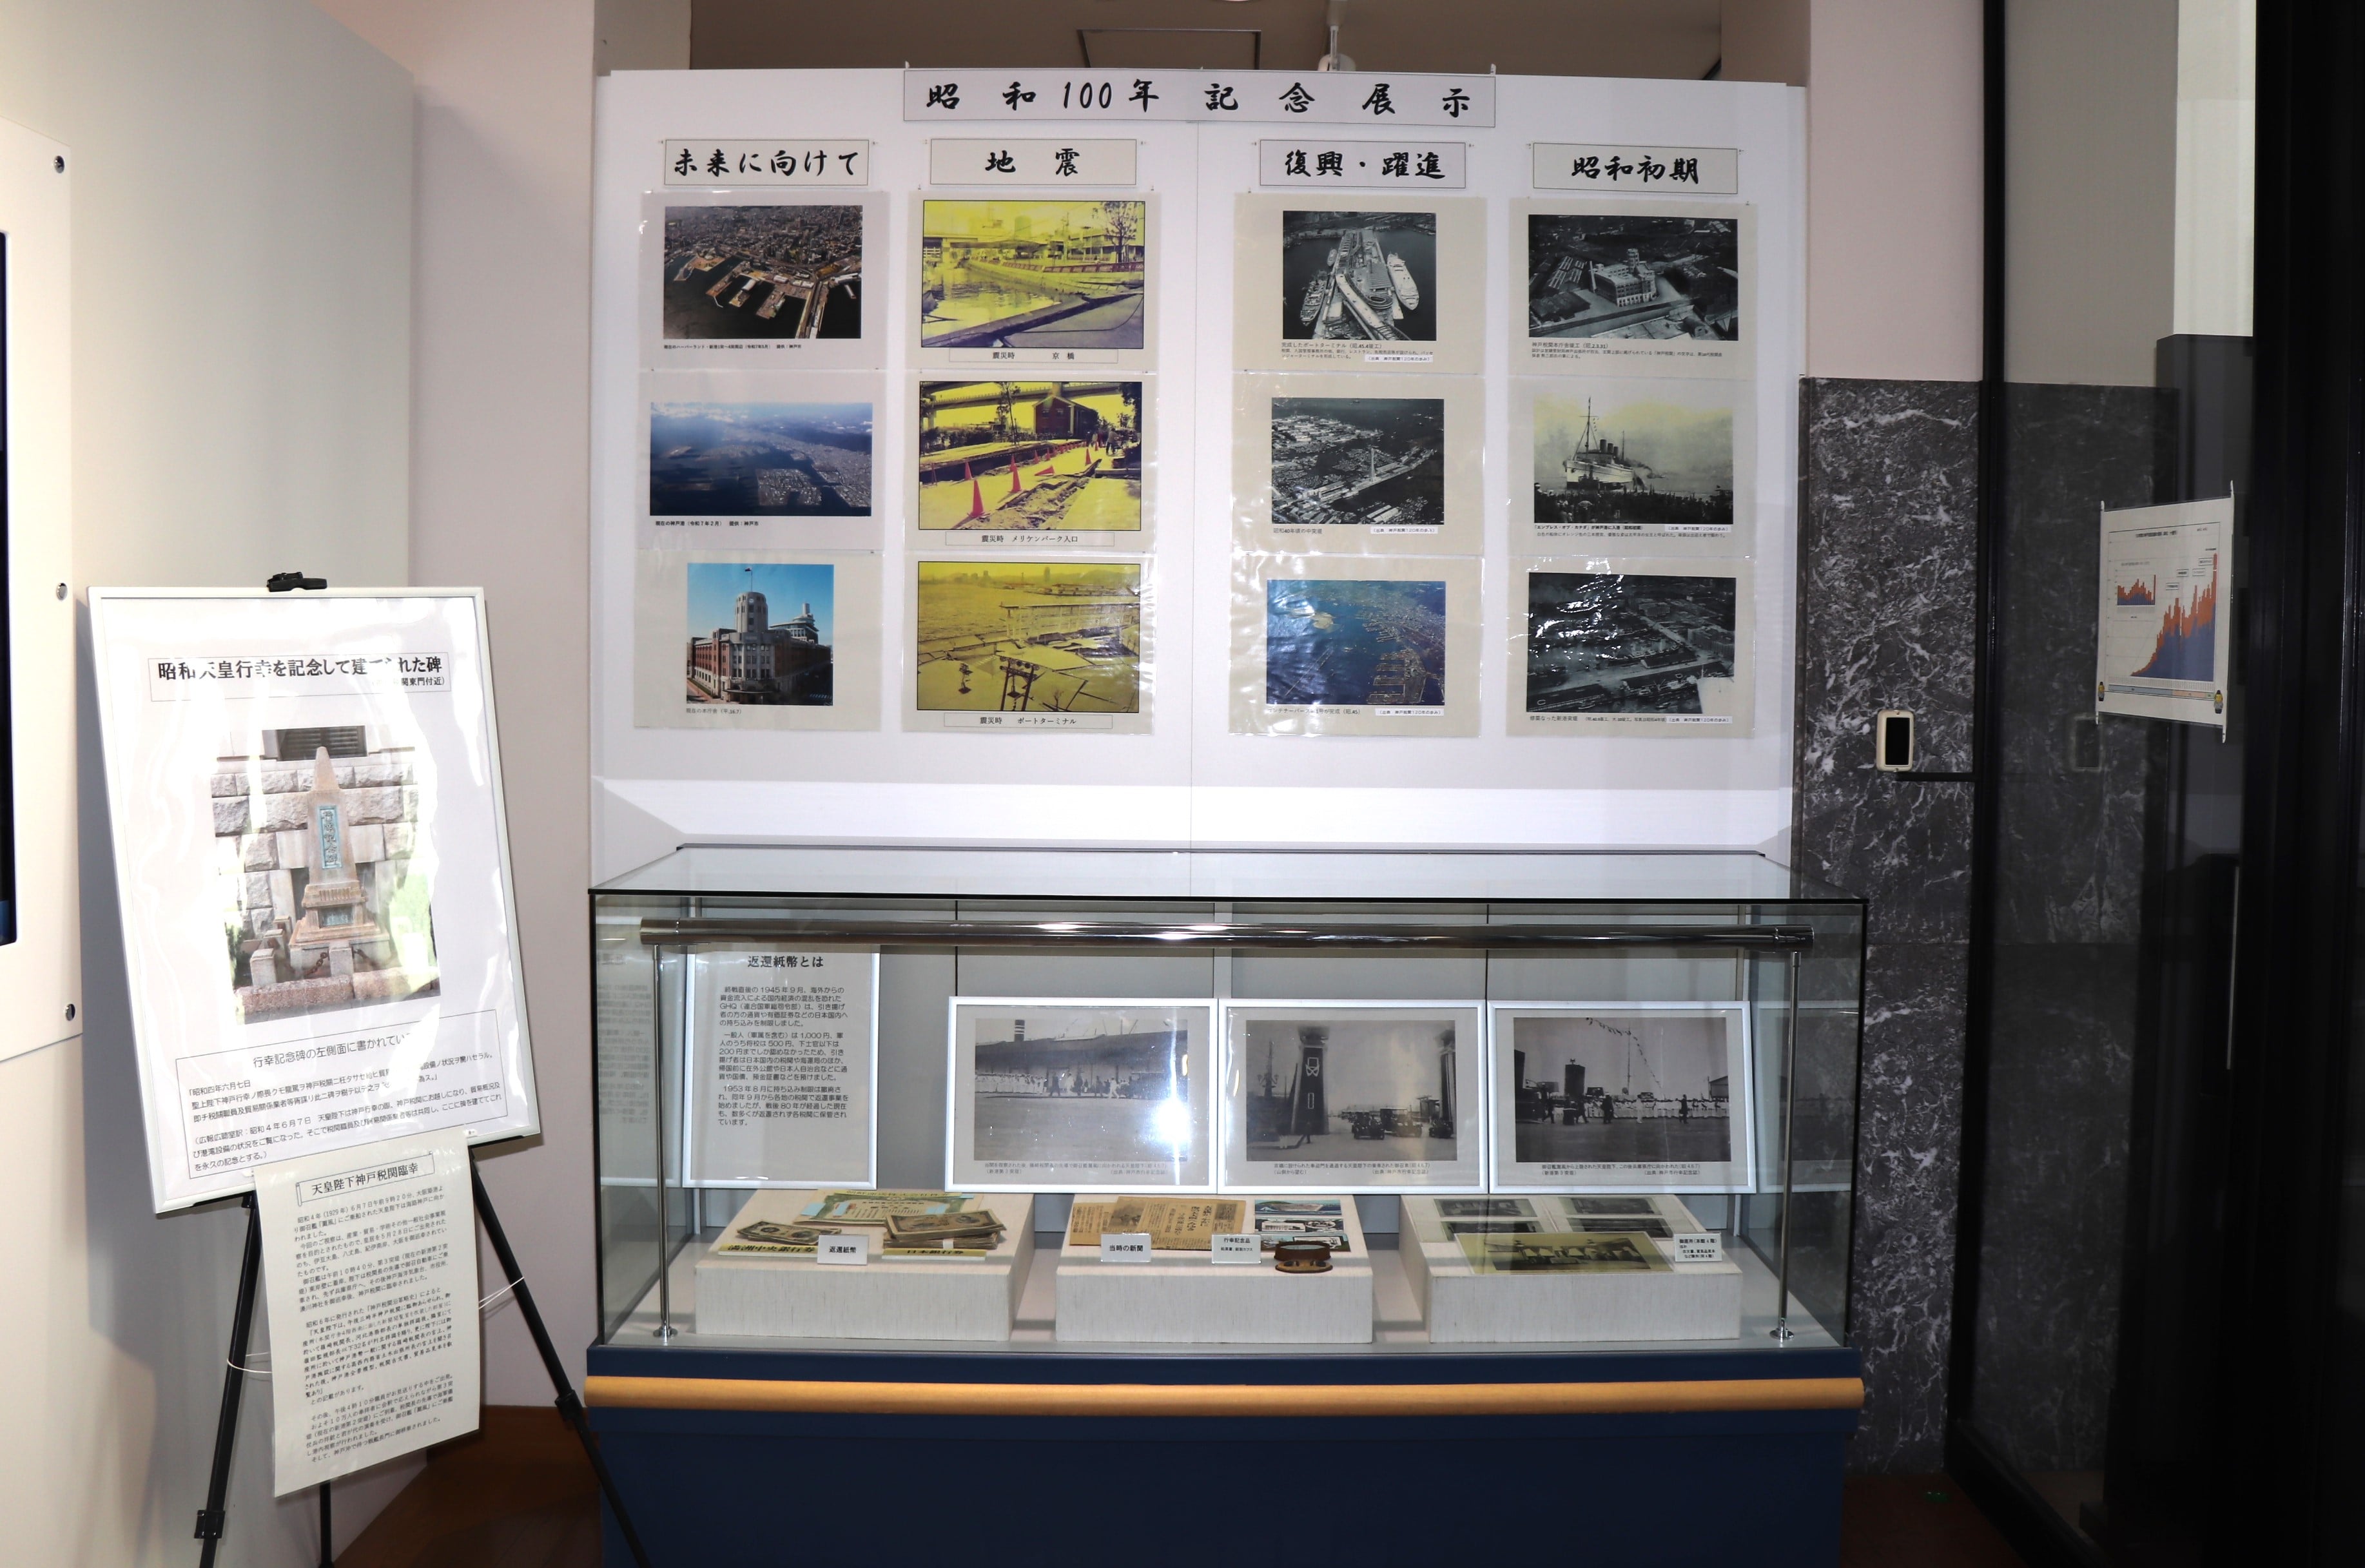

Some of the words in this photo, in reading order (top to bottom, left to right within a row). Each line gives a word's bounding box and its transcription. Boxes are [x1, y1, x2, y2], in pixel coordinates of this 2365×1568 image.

[674, 148, 858, 176] 未来に向けて
[985, 150, 1080, 175] 地震
[1285, 150, 1446, 179] 復興・躍進
[1570, 156, 1699, 184] 昭和初期
[159, 656, 442, 681] 昭和天皇行幸を記念して建れた碑
[1017, 717, 1076, 725] ポートターミナル
[748, 955, 824, 968] 返還紙幣とは
[253, 1032, 411, 1069] 行幸記念碑の左側面に書かれてい
[311, 1162, 418, 1195] 天皇陛下神戸税関臨幸
